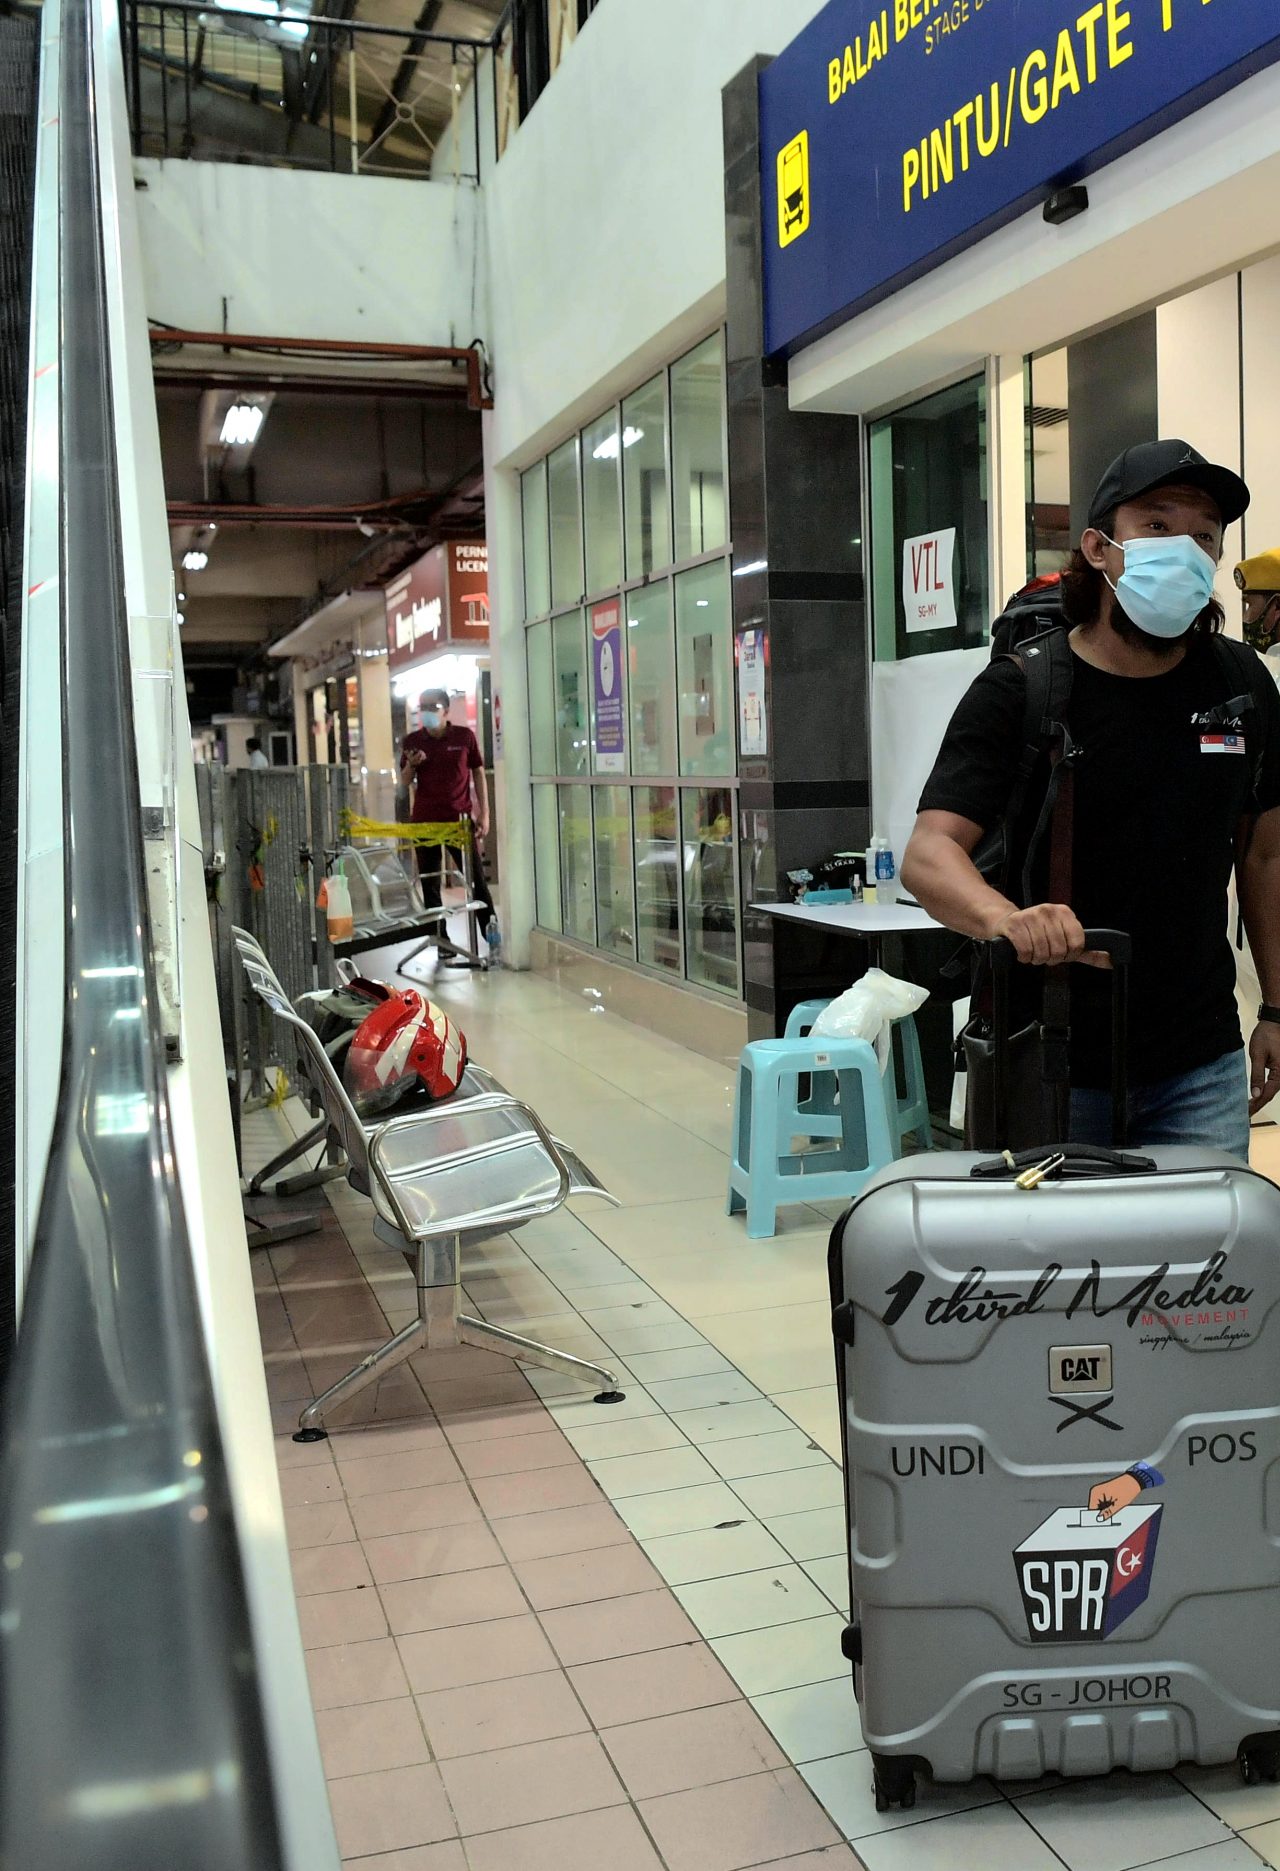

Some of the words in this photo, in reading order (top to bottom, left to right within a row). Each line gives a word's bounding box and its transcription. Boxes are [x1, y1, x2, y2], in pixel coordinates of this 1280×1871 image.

[925, 0, 969, 55] STAGE
[828, 10, 888, 104] BALAI
[902, 0, 1133, 212] PINTU/GATE
[911, 540, 945, 594] VTL
[918, 604, 938, 618] SG-MY
[883, 1270, 926, 1327] 1
[925, 1262, 1062, 1326] third
[1065, 1250, 1255, 1328] Media
[1139, 1334, 1190, 1351] singapore
[1203, 1325, 1251, 1347] malaysia
[1141, 1308, 1249, 1327] MOVEMENT
[1061, 1357, 1100, 1382] CAT
[891, 1445, 984, 1477] UNDI
[1188, 1431, 1258, 1466] POS
[1022, 1559, 1110, 1632] SPR
[1003, 1682, 1042, 1707] SG
[1069, 1674, 1172, 1704] JOHOR
